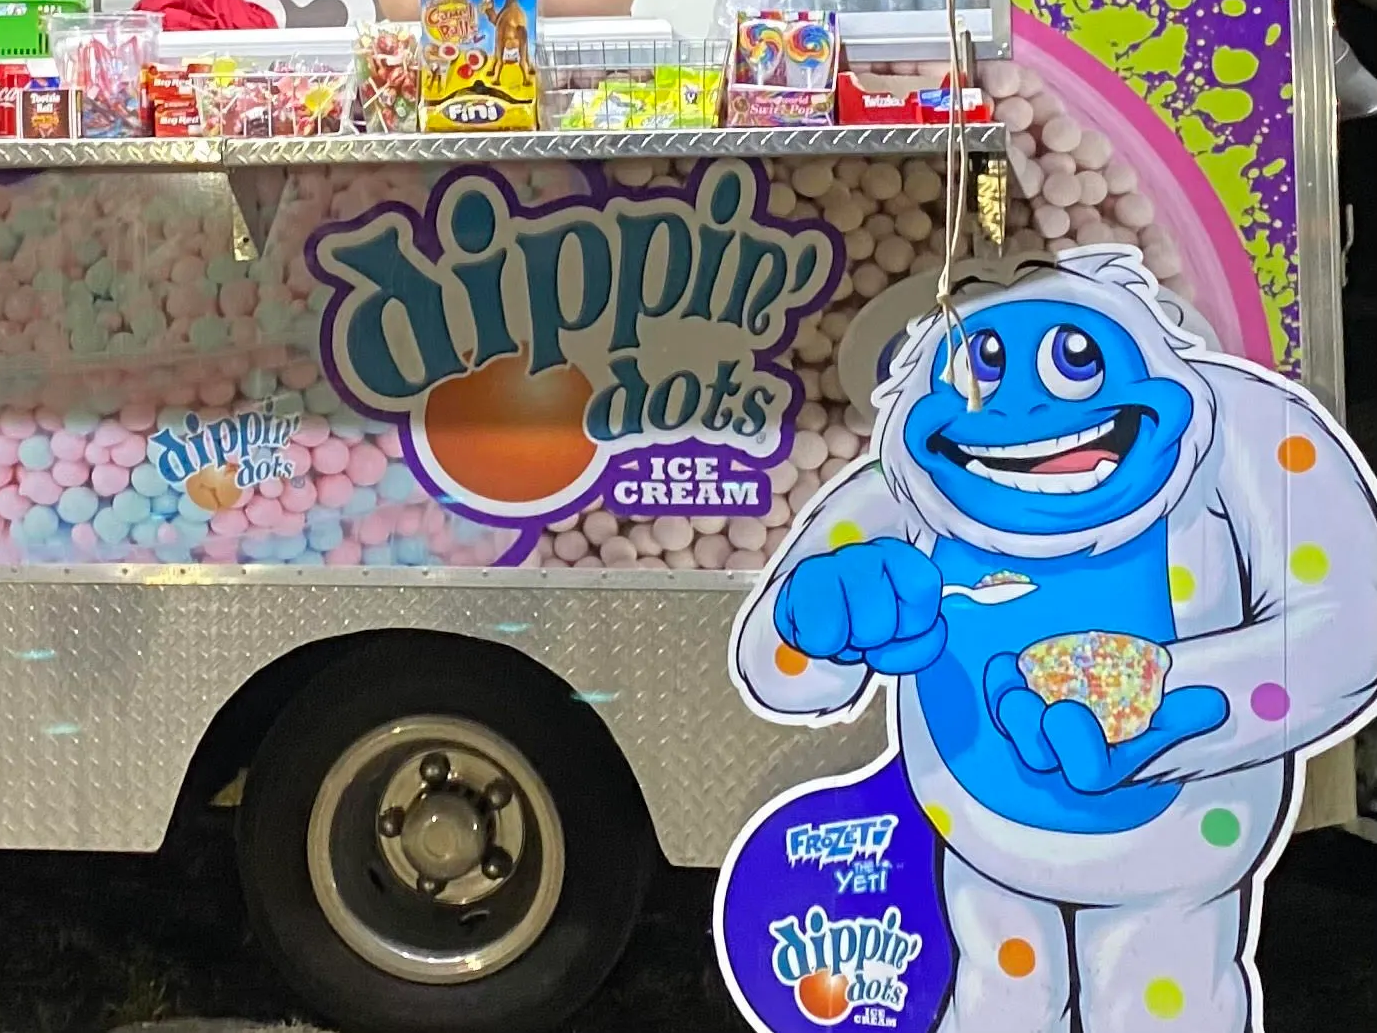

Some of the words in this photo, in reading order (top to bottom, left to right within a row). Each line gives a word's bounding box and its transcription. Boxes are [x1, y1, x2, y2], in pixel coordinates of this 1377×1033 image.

[332, 170, 817, 398] dippin'
[586, 356, 775, 442] dots
[236, 454, 294, 487] dots
[649, 456, 719, 481] ICE
[613, 481, 760, 506] CREAM
[773, 911, 917, 980] dippin'
[846, 973, 904, 1005] dots
